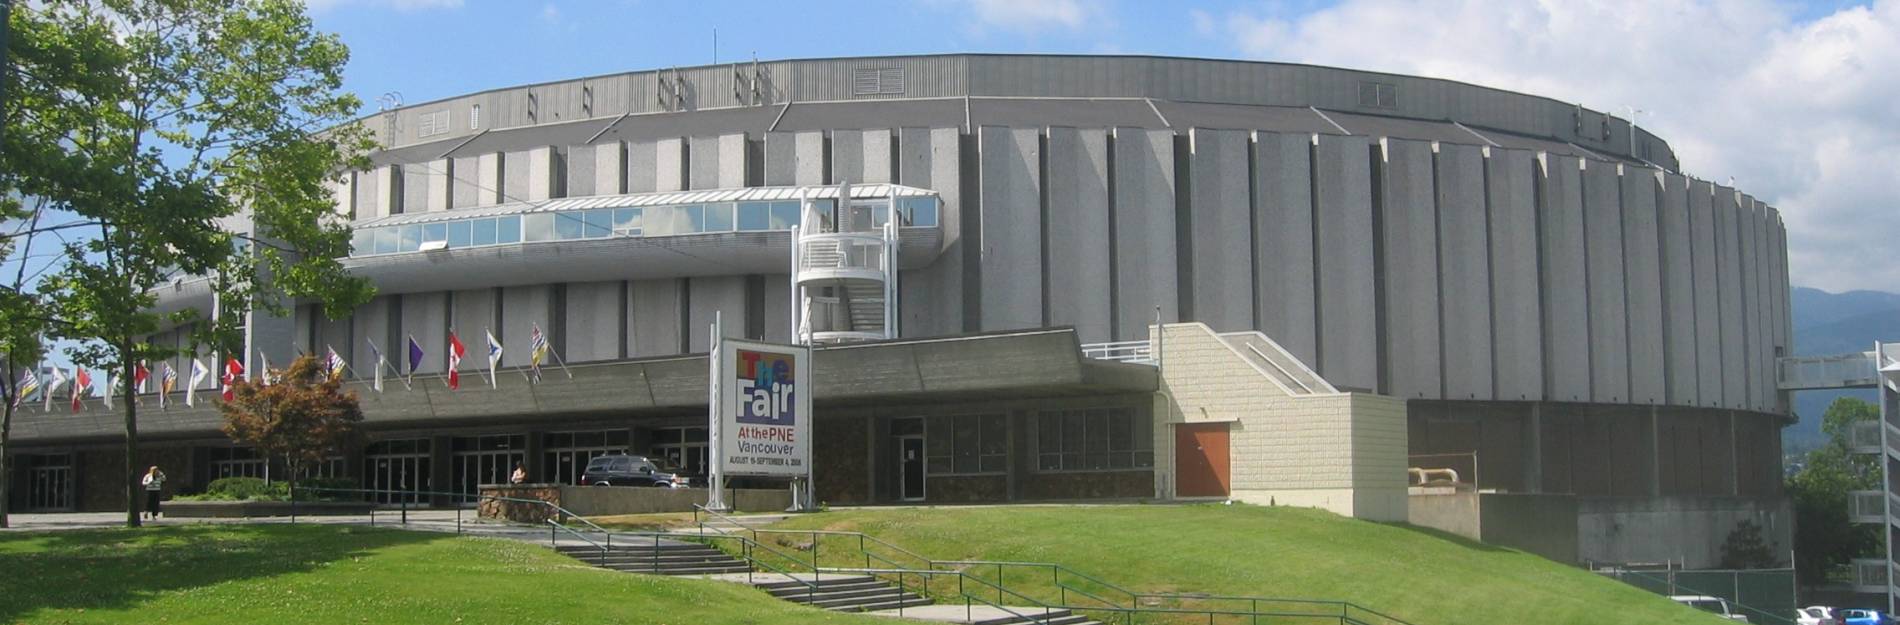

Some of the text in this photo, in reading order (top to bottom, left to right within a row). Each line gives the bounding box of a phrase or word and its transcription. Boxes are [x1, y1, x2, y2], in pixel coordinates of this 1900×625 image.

[742, 351, 790, 387] The
[736, 378, 794, 420] Fair
[738, 426, 795, 442] At the PNE
[738, 440, 794, 456] Vancouver
